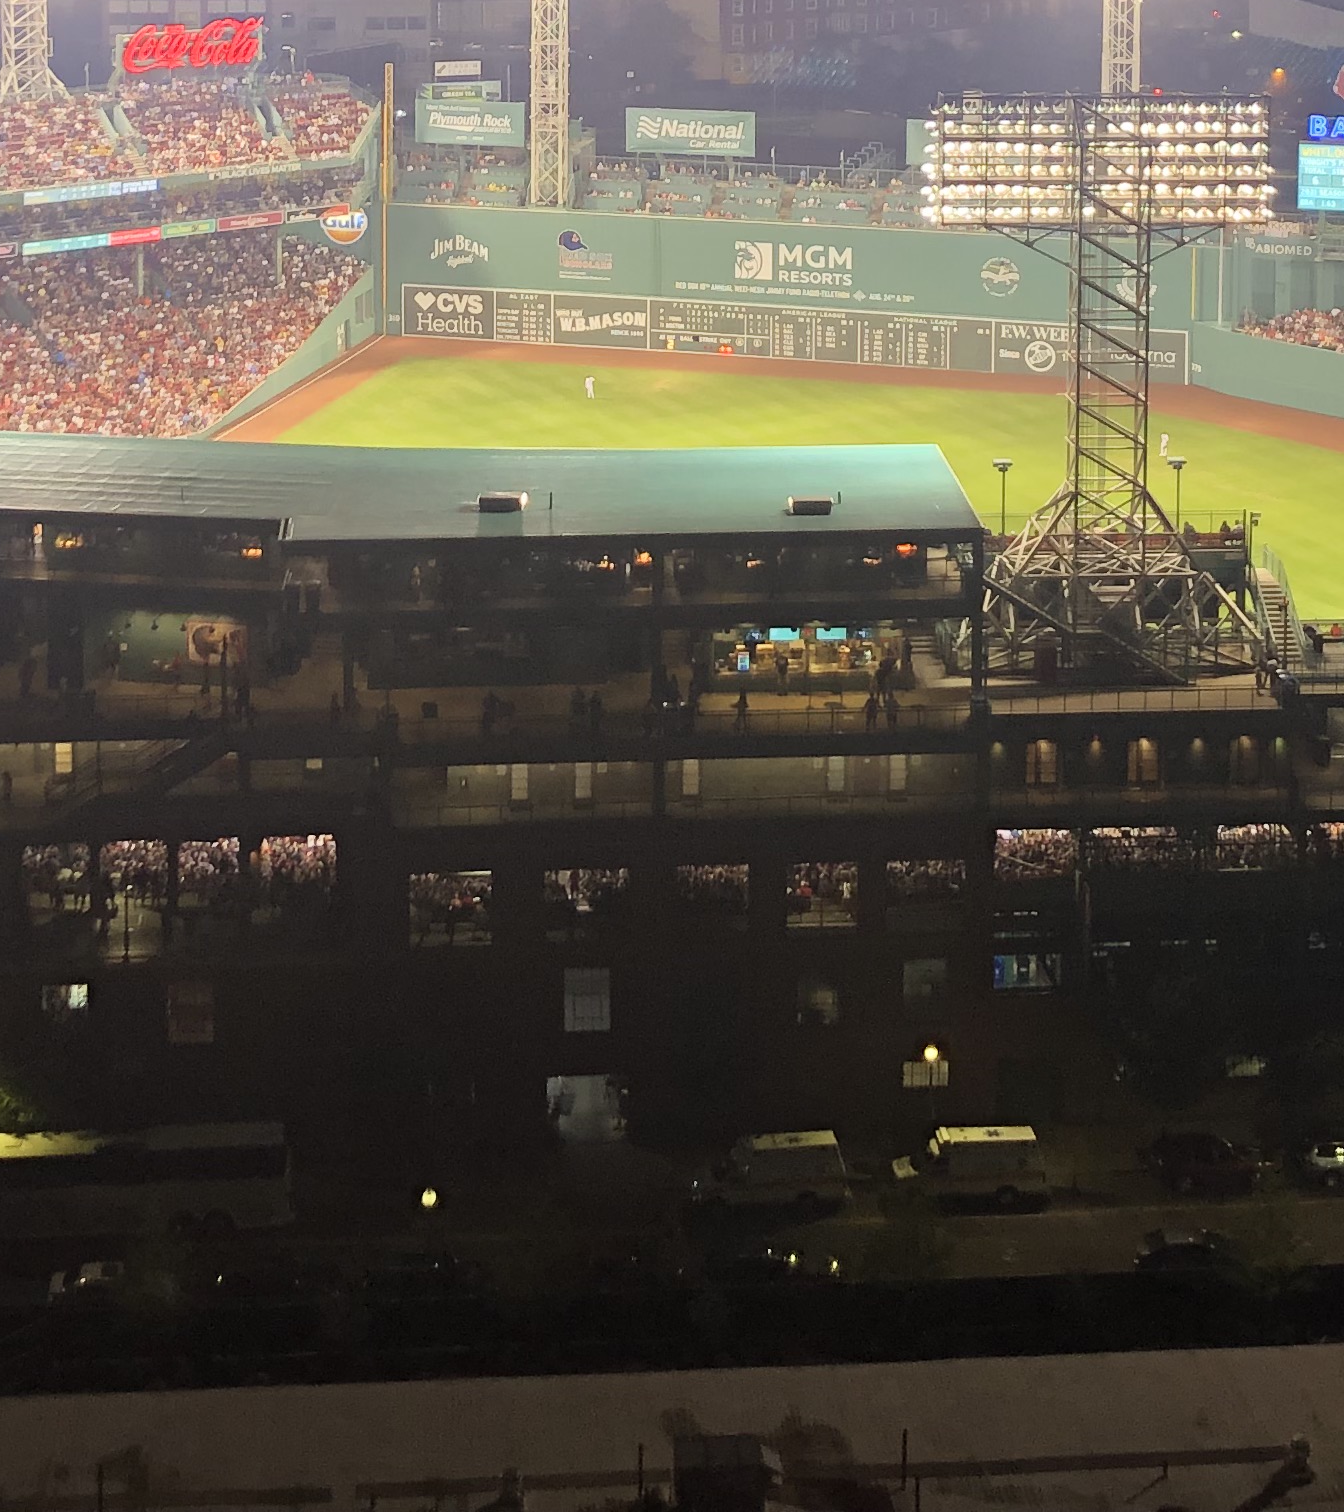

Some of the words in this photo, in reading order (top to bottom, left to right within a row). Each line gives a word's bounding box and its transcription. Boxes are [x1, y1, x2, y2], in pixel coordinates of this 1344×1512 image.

[122, 16, 264, 74] Coca-Cola
[429, 111, 482, 127] Plymouth
[483, 113, 512, 128] Rock
[689, 139, 706, 148] Car
[708, 140, 740, 149] Rental
[324, 211, 365, 229] Gulf
[430, 238, 454, 260] JIM
[455, 234, 490, 262] BEAM
[778, 243, 853, 270] MGM
[1254, 243, 1313, 256] ABIOMED
[778, 270, 853, 287] RESORTS
[436, 292, 484, 313] CVS
[781, 309, 817, 317] AMERICAN
[893, 316, 928, 325] NATIONAL
[416, 312, 484, 335] Health
